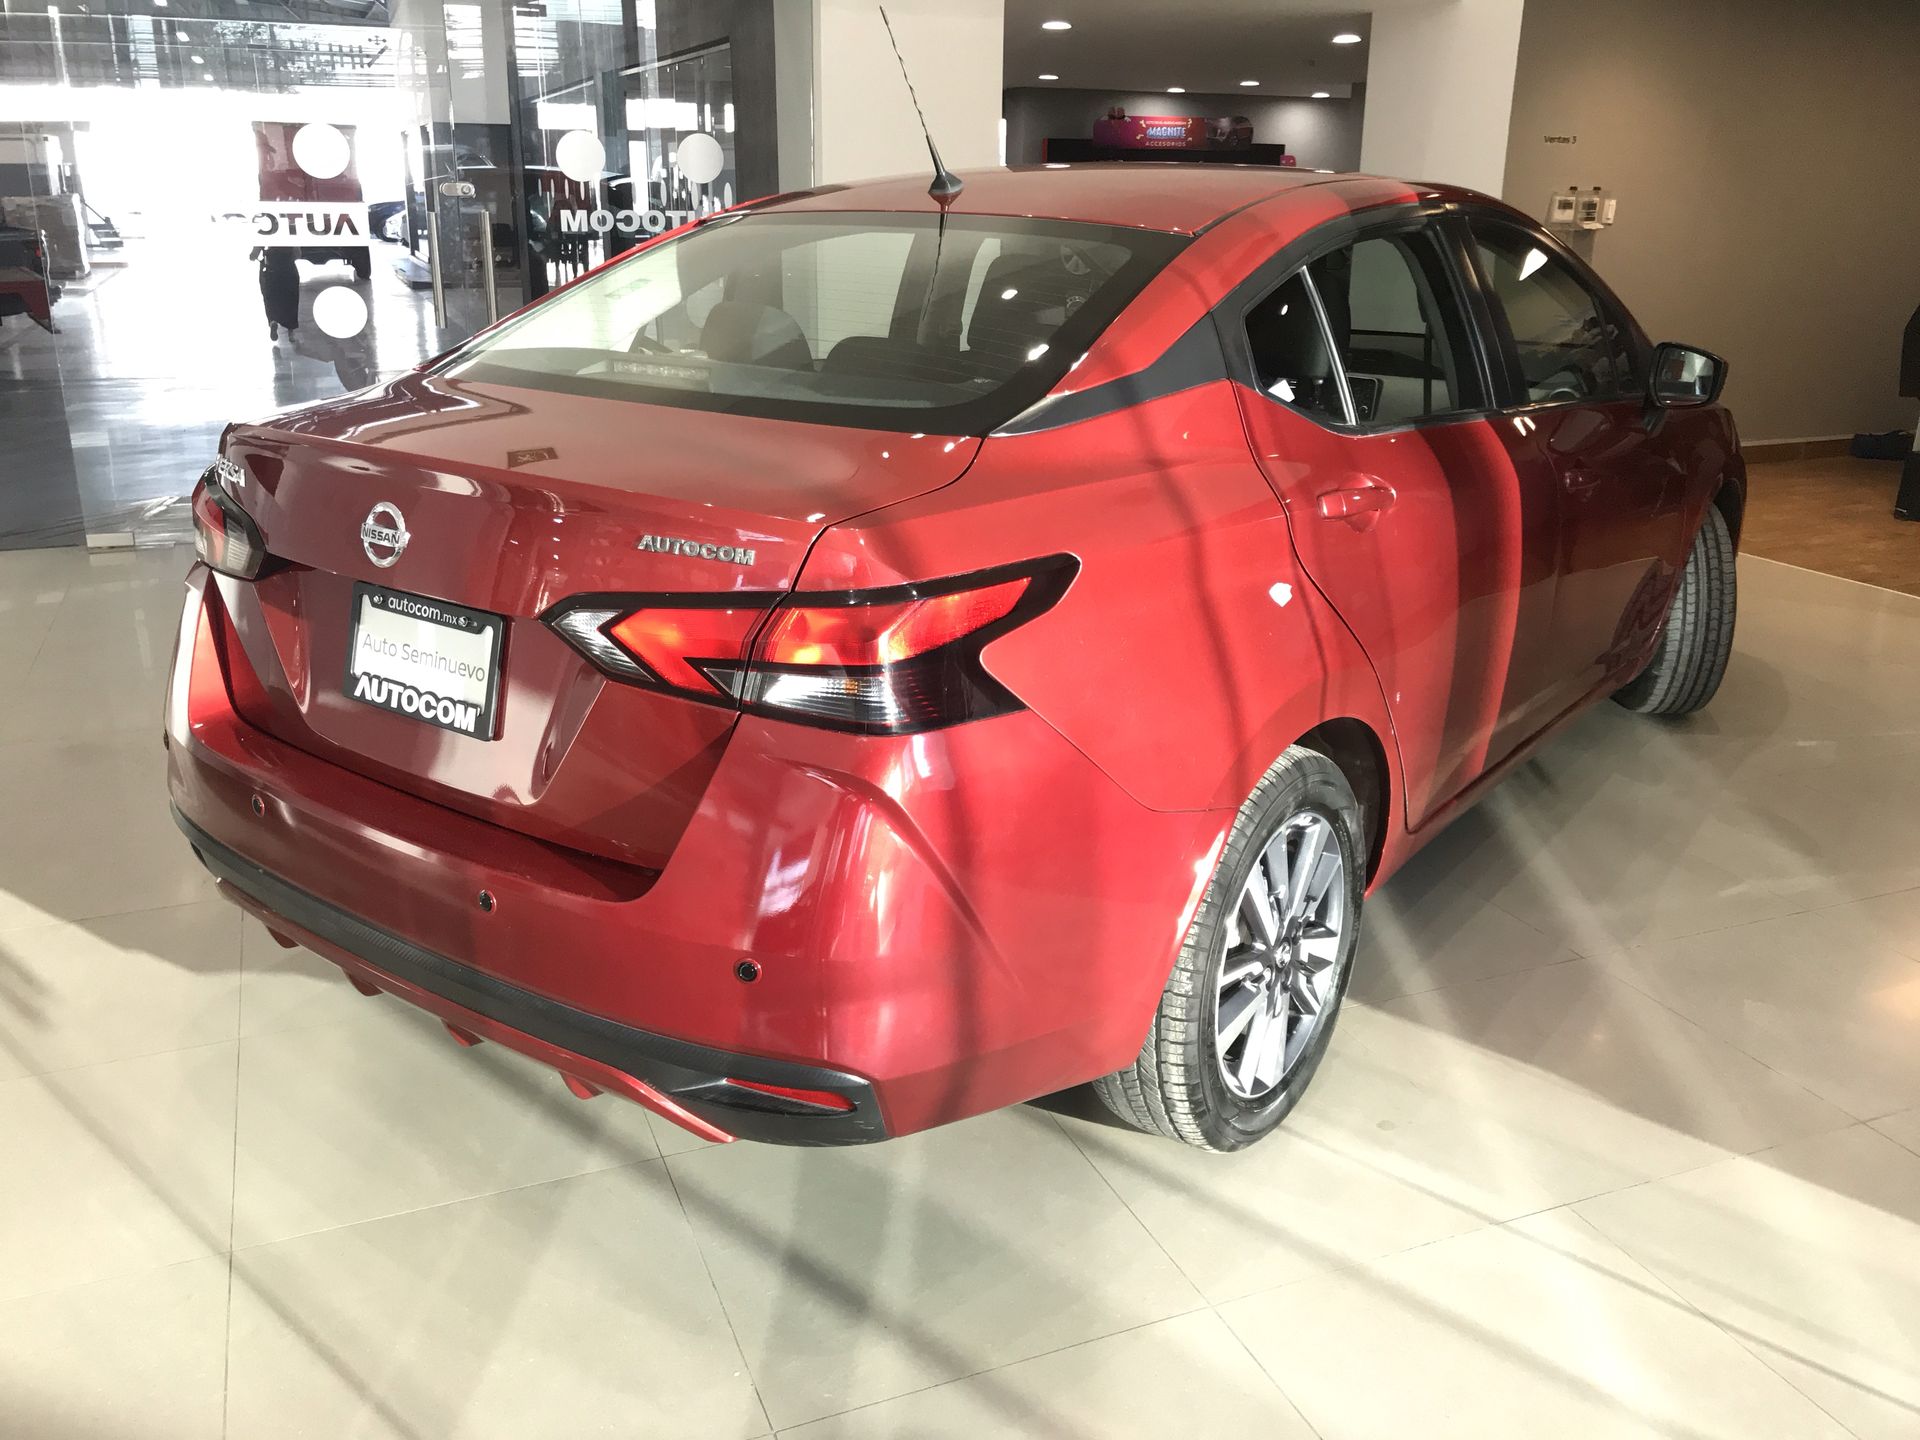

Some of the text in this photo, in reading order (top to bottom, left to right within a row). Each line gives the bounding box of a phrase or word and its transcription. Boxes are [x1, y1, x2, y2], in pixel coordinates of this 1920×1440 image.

[1146, 126, 1187, 138] MAGNITE
[362, 525, 401, 544] NISSAN
[637, 534, 757, 566] AUTOCOM
[387, 597, 458, 626] autocom.mx
[362, 633, 486, 682] Auto Seminuevo
[353, 673, 477, 733] AUTOCOM
